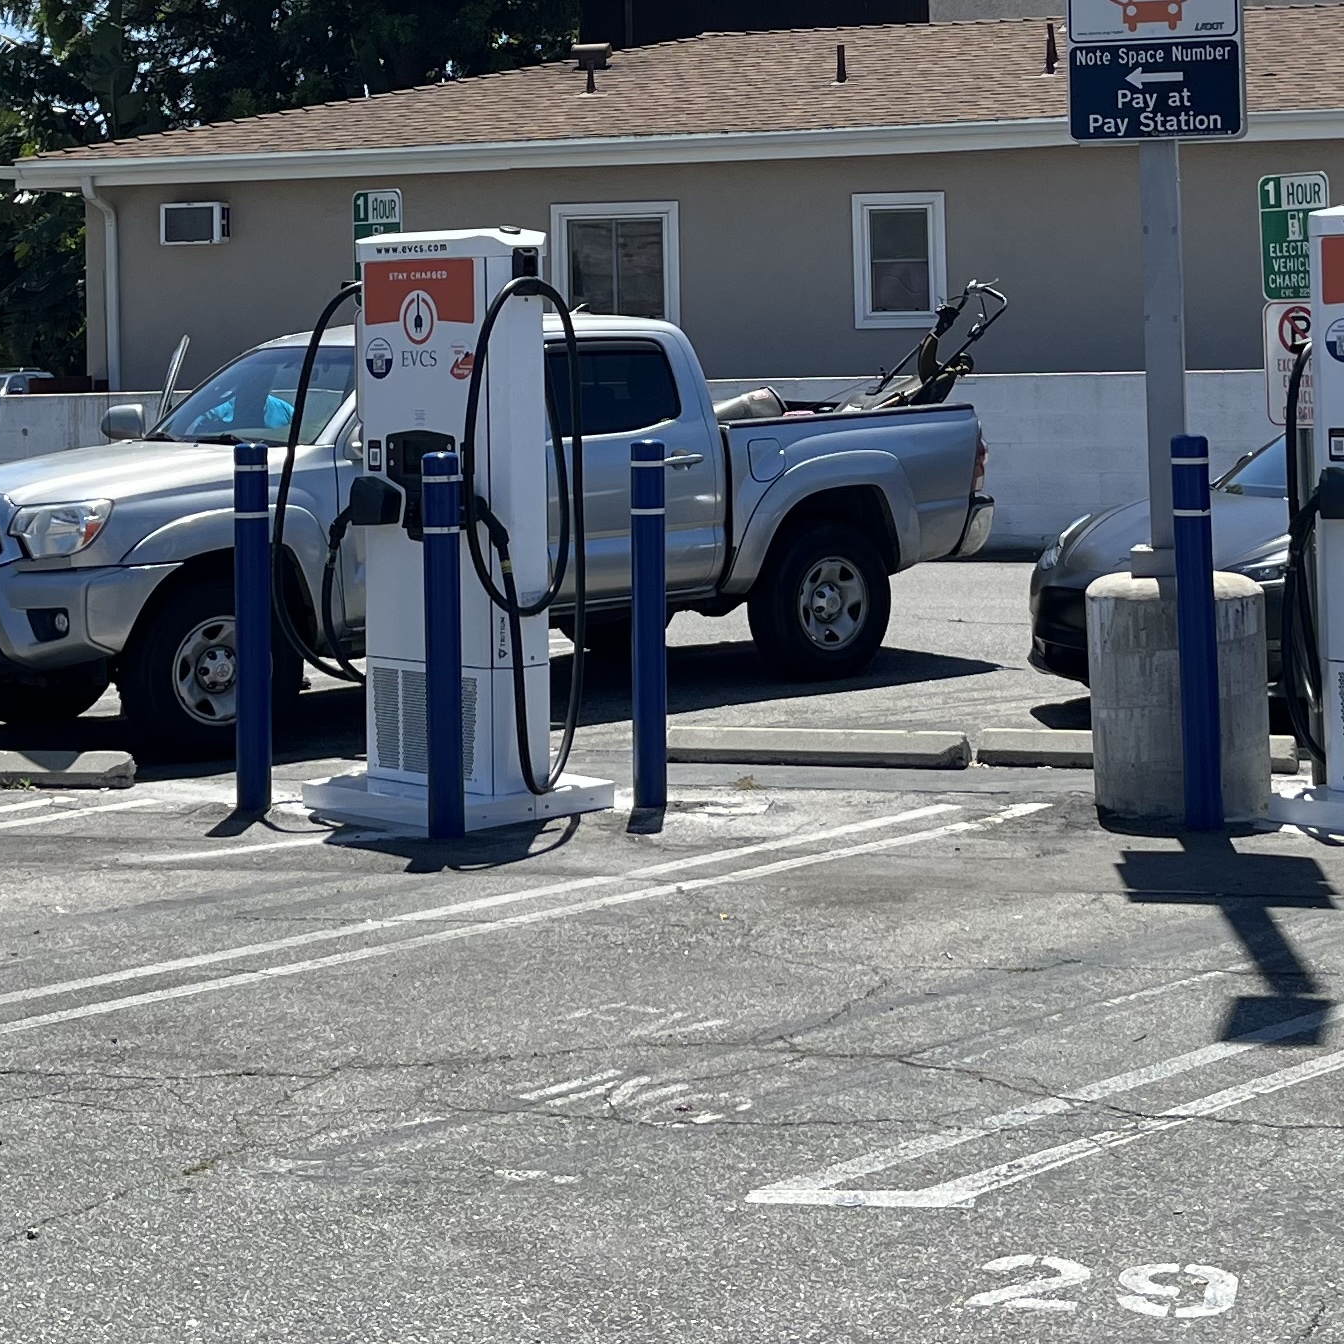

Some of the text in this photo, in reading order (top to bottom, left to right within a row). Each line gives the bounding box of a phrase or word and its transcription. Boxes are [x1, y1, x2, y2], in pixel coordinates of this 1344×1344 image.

[1076, 46, 1231, 67] Note Space Number
[1118, 88, 1191, 111] Pay at
[1088, 111, 1222, 136] Pay Station
[1264, 180, 1321, 206] 1 HOUR
[356, 196, 396, 220] 1 HOUR
[376, 243, 448, 254] www.evcs.com
[389, 270, 448, 280] STAY CHARGED
[401, 350, 438, 367] EVCS
[964, 1254, 1239, 1318] 29
